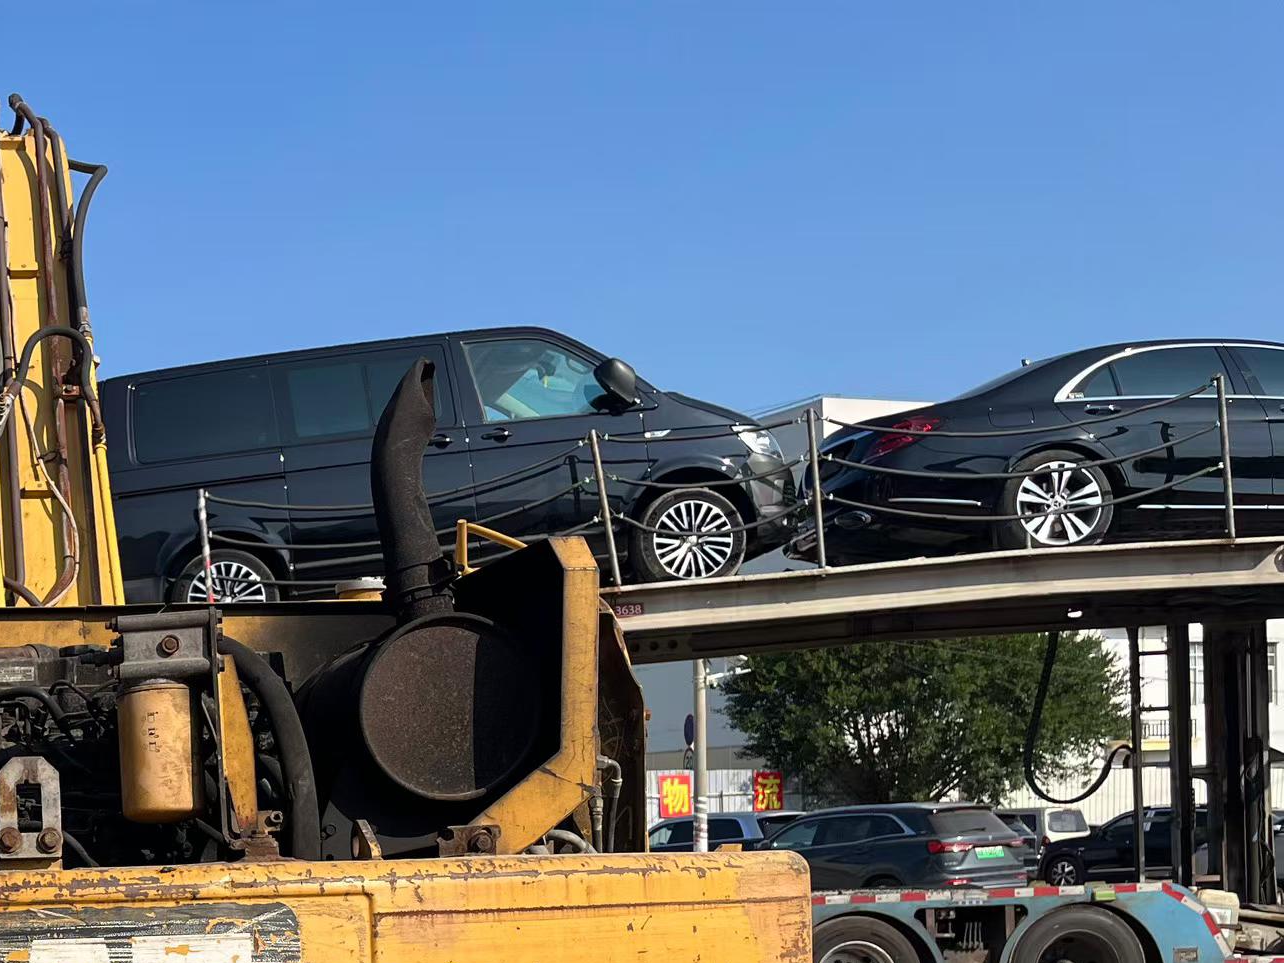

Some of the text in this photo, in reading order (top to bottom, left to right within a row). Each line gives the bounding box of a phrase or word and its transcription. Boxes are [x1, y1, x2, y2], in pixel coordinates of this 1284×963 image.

[616, 604, 642, 616] 3638
[662, 776, 781, 814] 物 流
